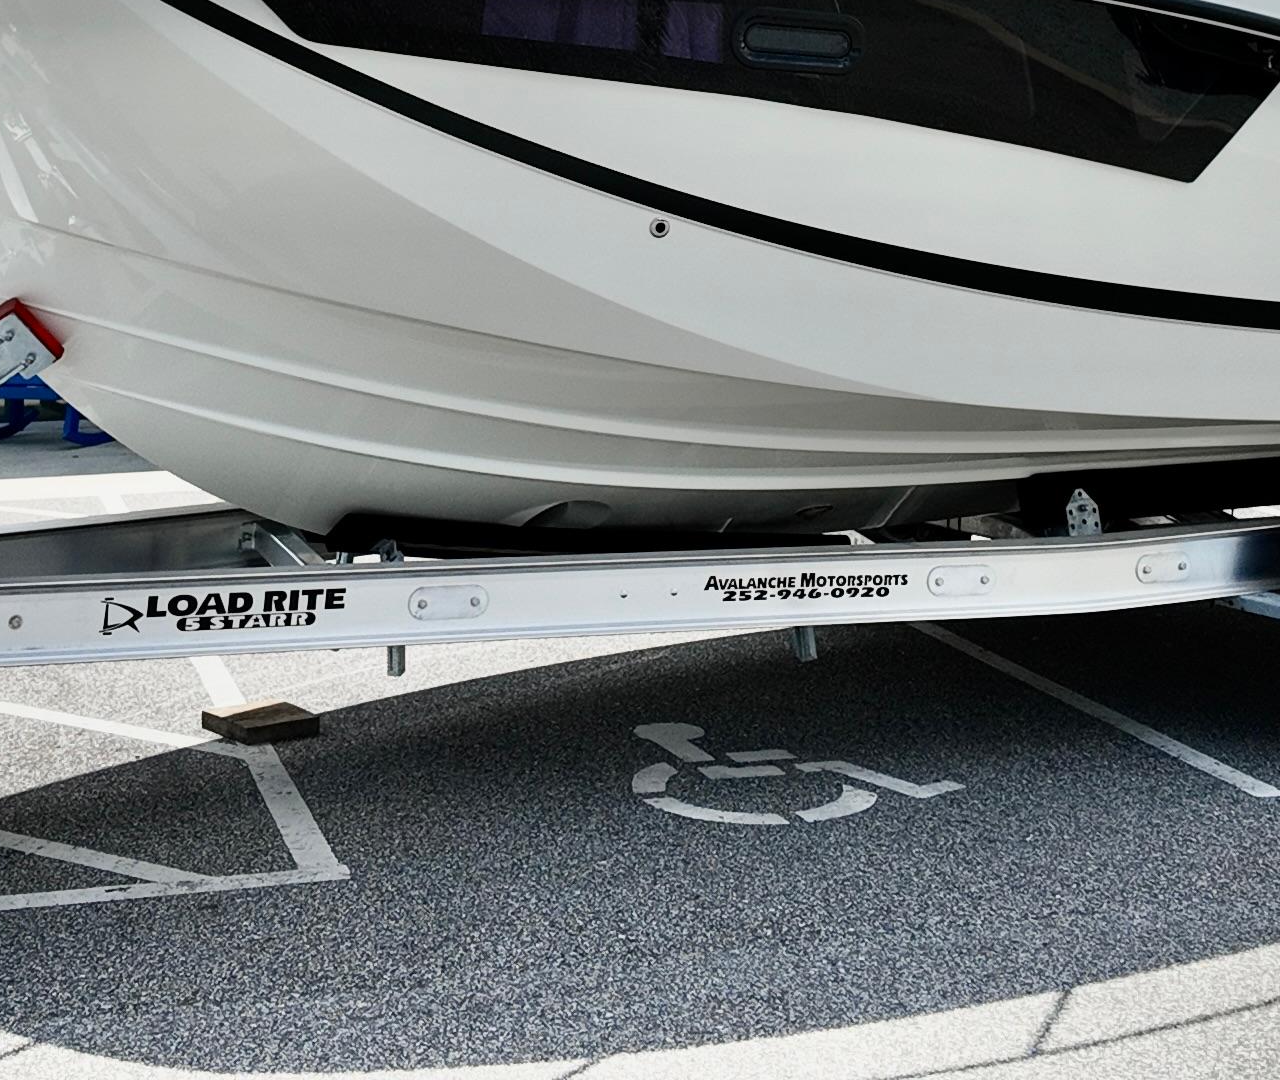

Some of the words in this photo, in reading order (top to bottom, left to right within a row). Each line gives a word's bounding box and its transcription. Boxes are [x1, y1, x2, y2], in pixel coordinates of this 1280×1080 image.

[146, 592, 254, 618] LOAD
[263, 588, 347, 612] RITE
[722, 586, 890, 601] 252-946-0920
[184, 617, 201, 631] 5
[209, 612, 309, 630] STARR
